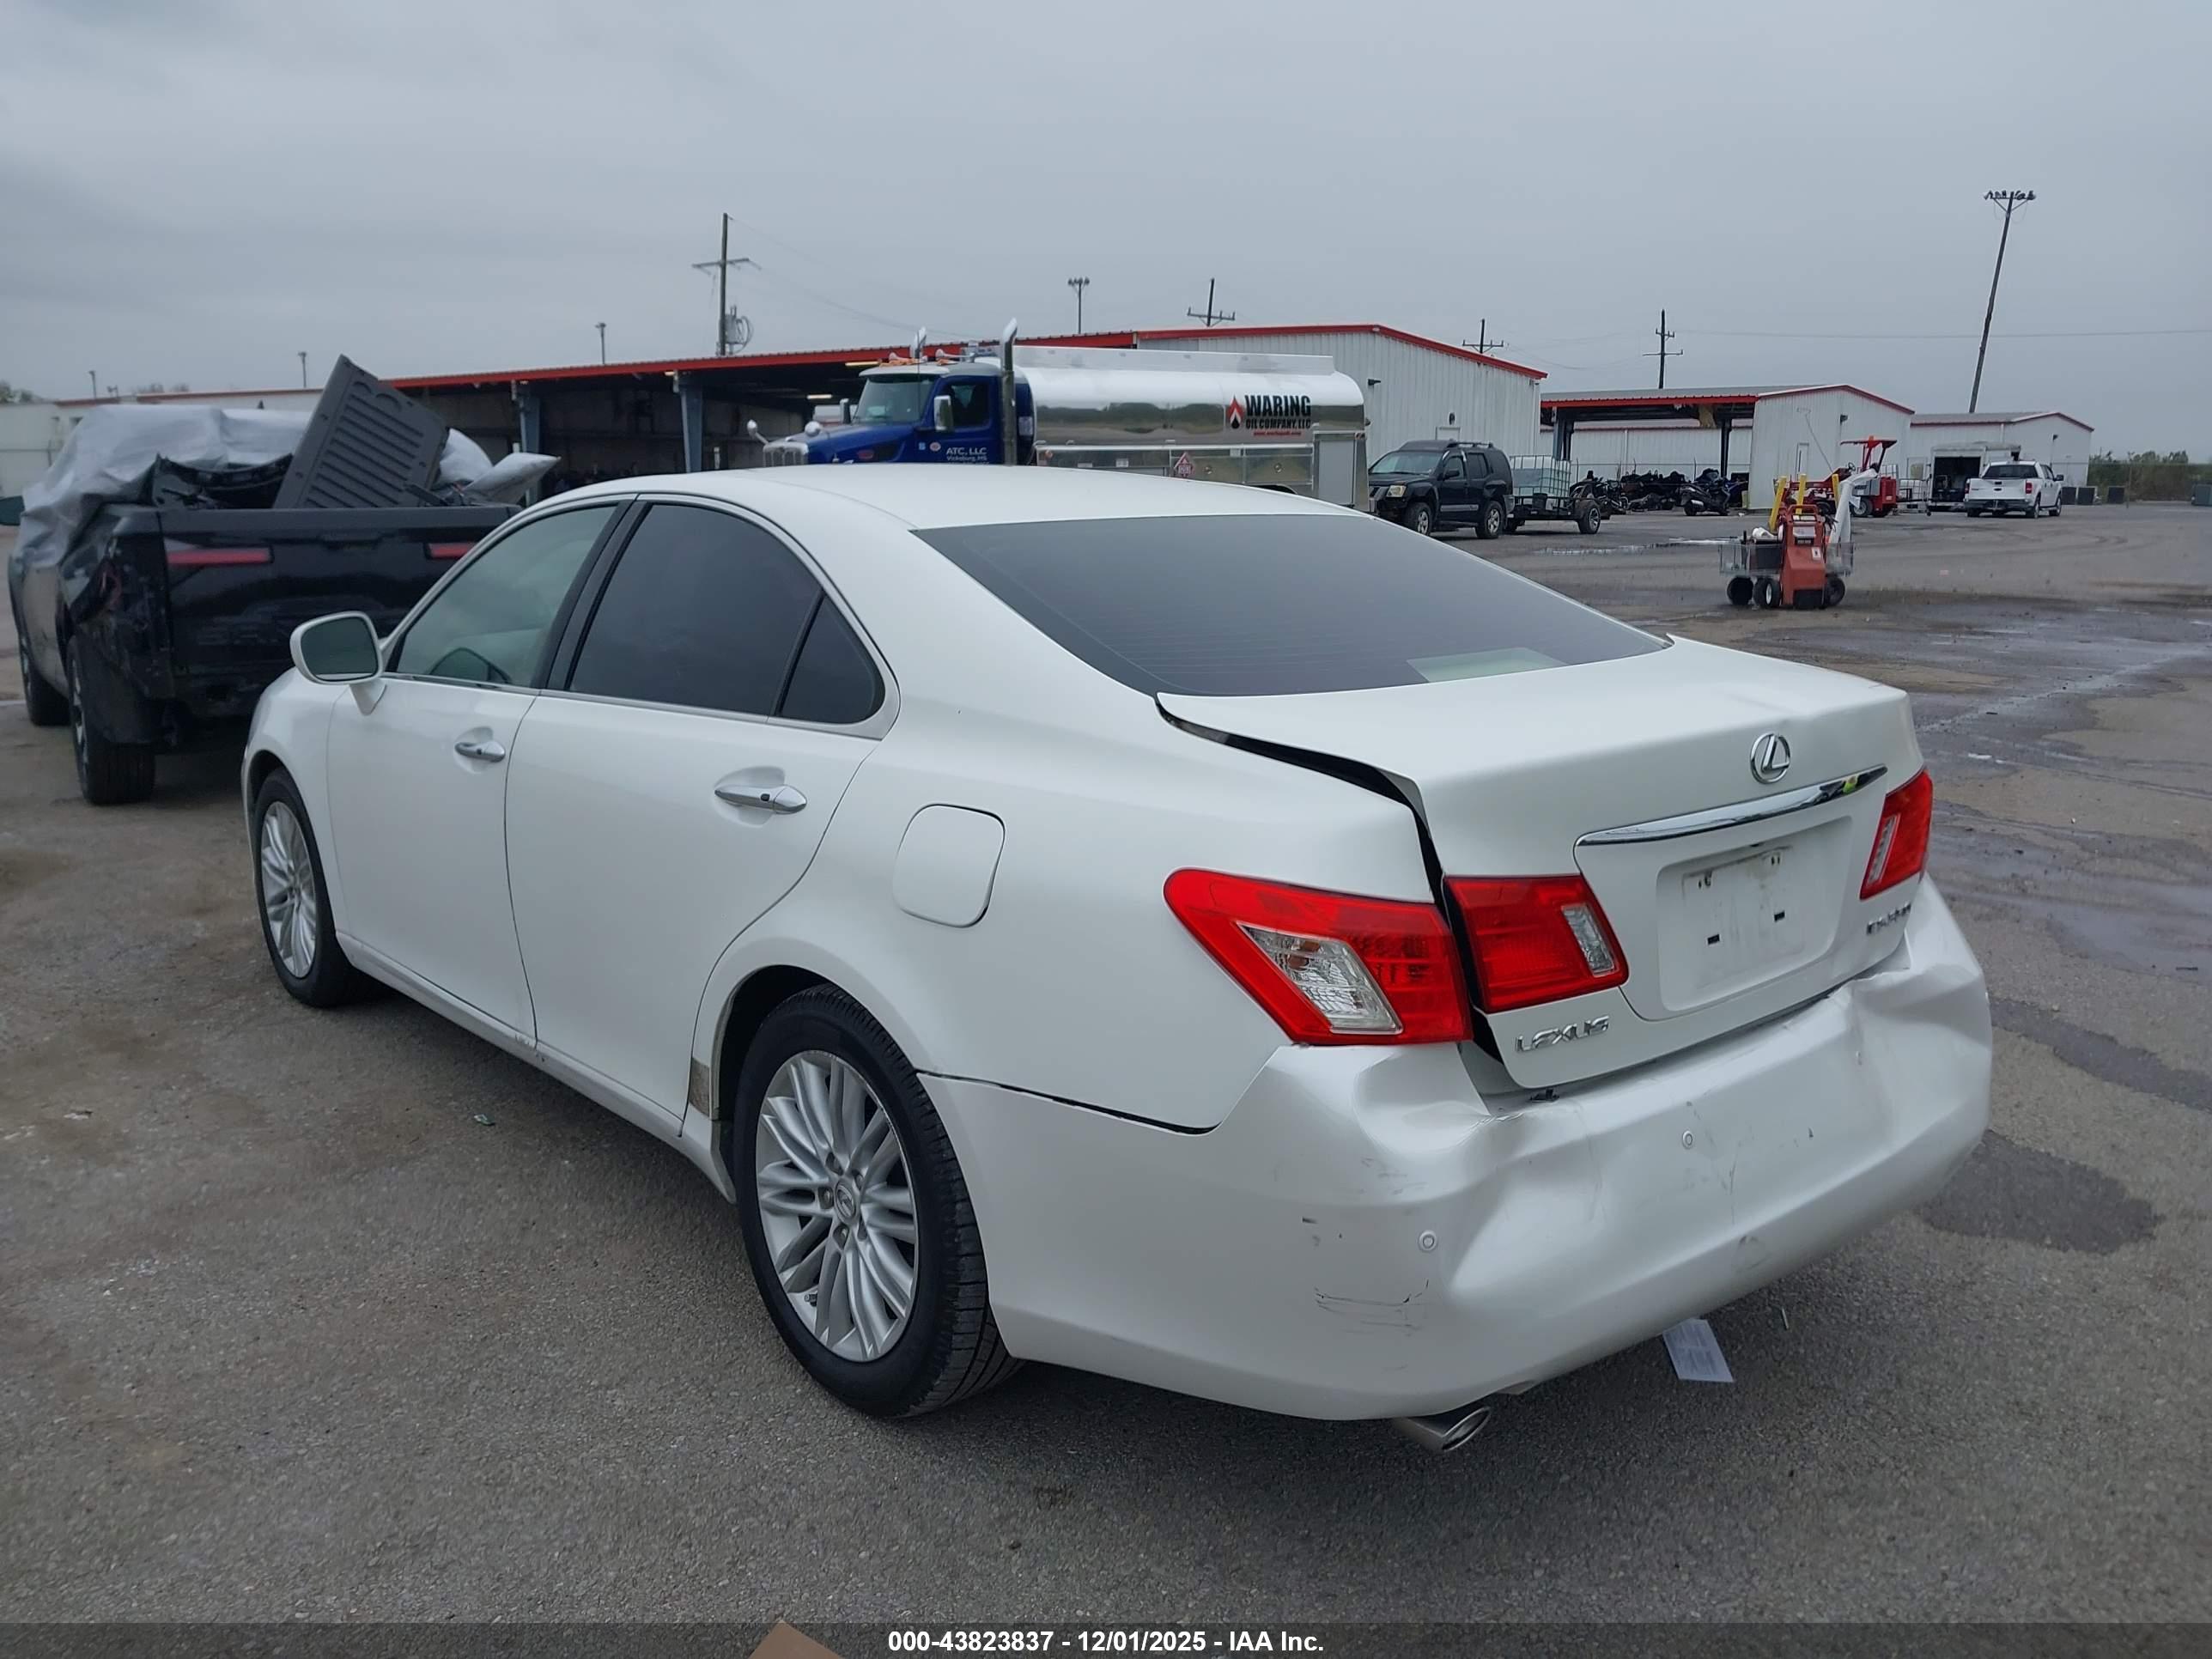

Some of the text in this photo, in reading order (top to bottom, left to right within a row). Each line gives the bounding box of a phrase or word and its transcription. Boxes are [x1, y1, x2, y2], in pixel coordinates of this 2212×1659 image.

[1244, 395, 1311, 416] WARING
[1246, 419, 1257, 429] OIL
[946, 447, 968, 456] ATC,
[1515, 1015, 1610, 1053] LEXUS
